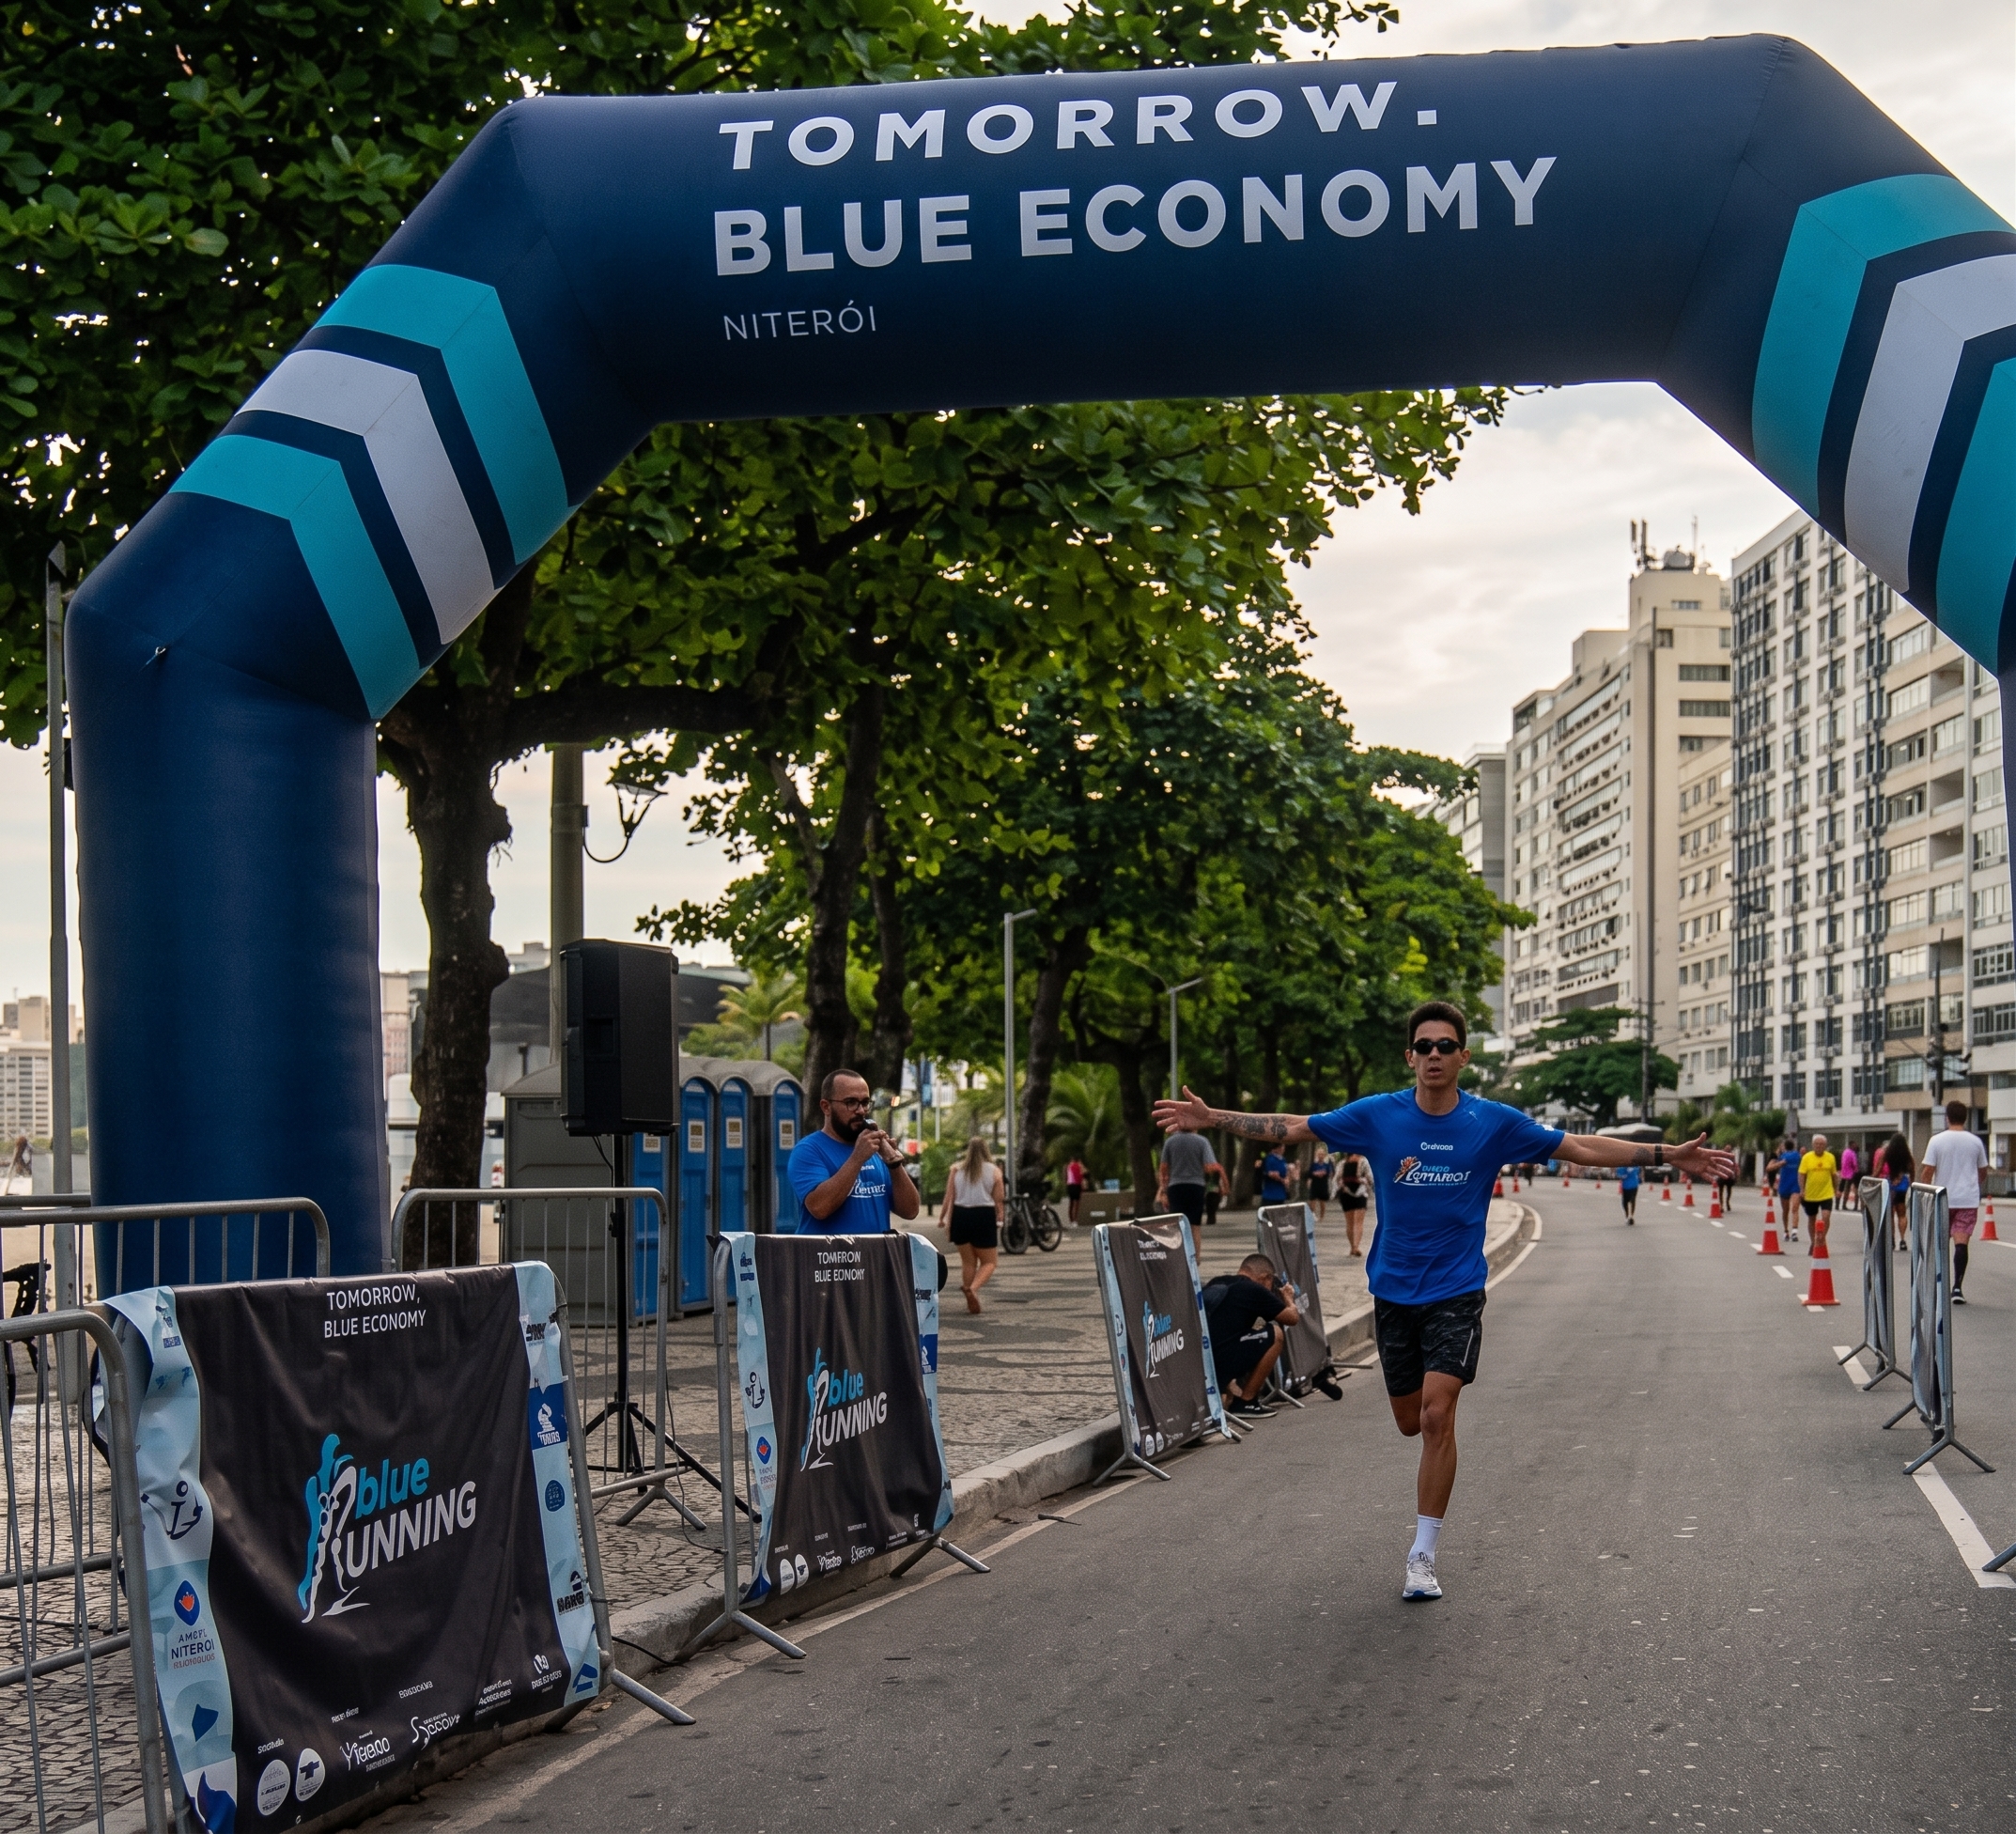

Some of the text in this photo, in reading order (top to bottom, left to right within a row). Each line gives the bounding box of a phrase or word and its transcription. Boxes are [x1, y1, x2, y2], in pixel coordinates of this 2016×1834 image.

[719, 81, 1437, 170] TOMORROW.
[714, 156, 1558, 276] BLUE ECONOMY
[723, 299, 877, 341] NITERÓI
[326, 1283, 421, 1311] TOMORROW,
[324, 1309, 426, 1339] BLUE ECONOMY
[828, 1369, 864, 1407] blue
[355, 1457, 430, 1520] blue
[171, 1638, 215, 1660] NITEROI
